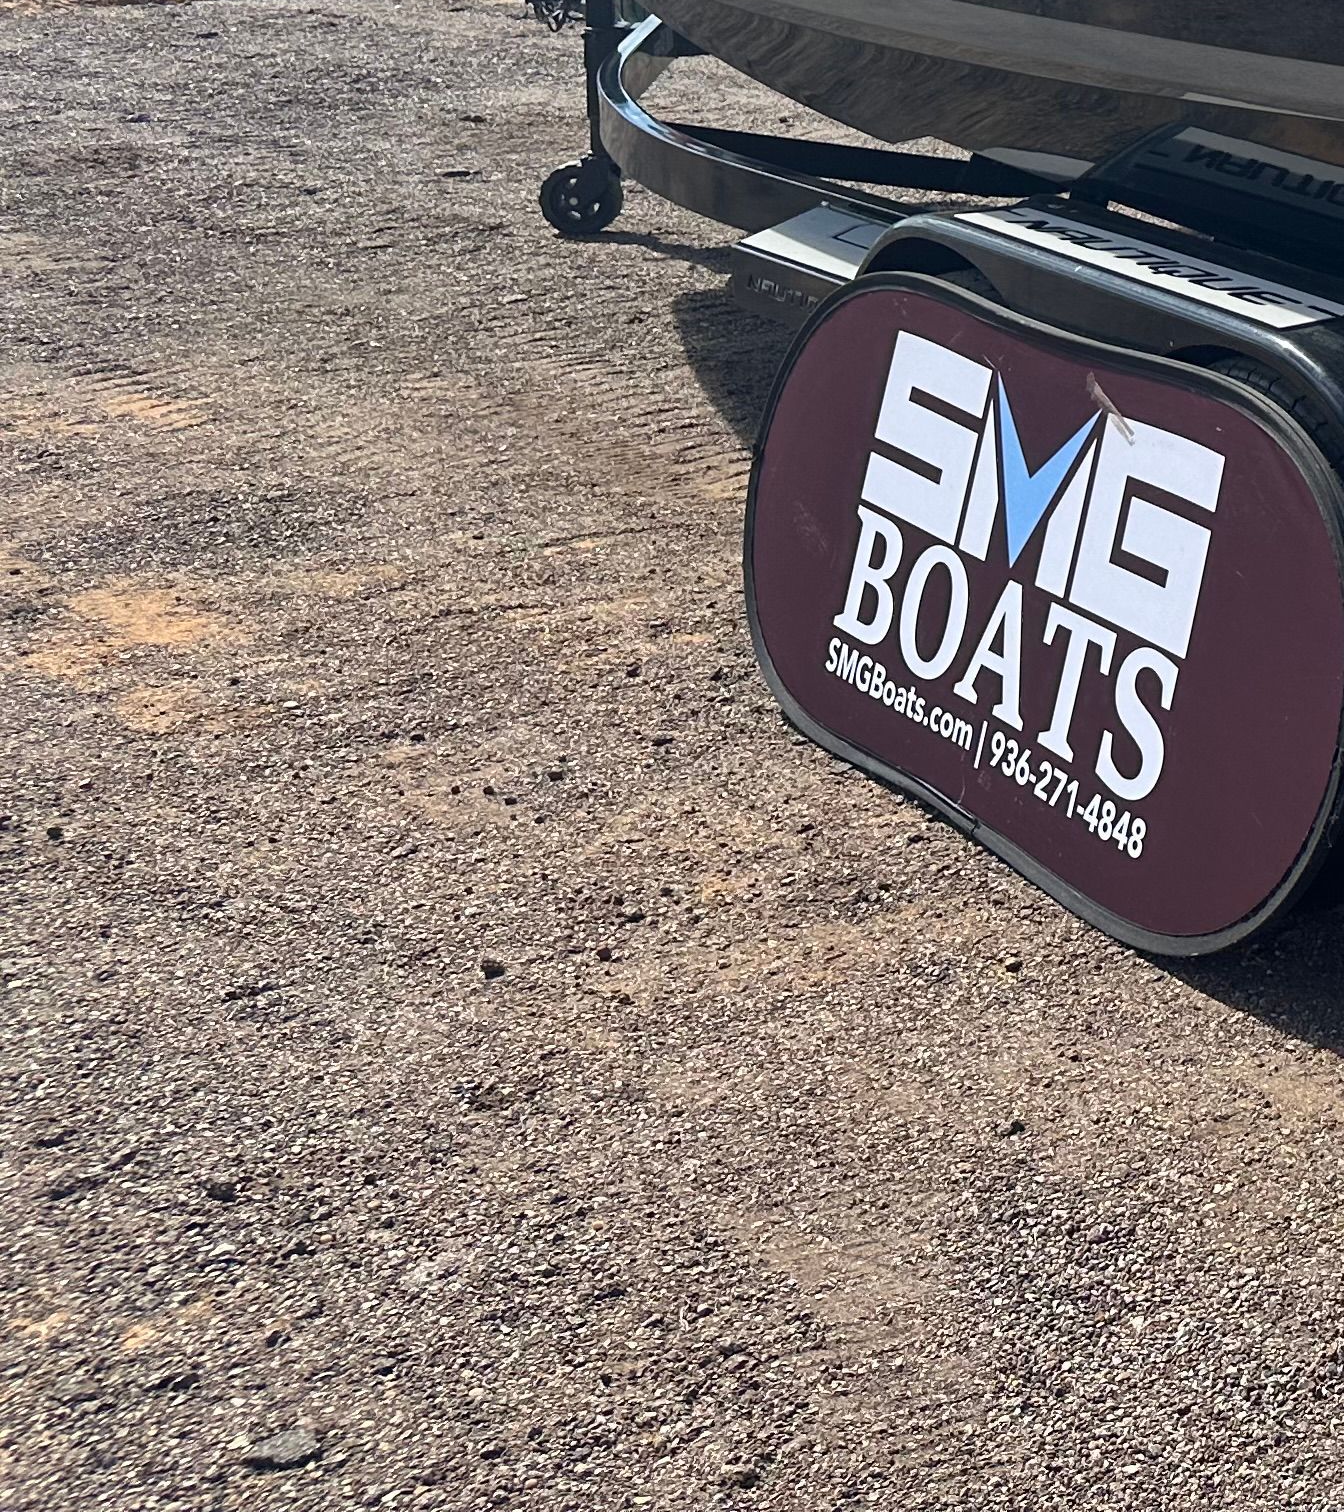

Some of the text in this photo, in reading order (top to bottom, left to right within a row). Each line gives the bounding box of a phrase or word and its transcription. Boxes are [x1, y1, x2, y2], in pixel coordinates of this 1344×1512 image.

[1006, 219, 1303, 305] NAUTIQUE
[861, 330, 1226, 659] SMG
[825, 637, 974, 751] SMGBoats.com
[989, 731, 1147, 859] 936-271-4848
[833, 504, 1180, 802] BOATS
